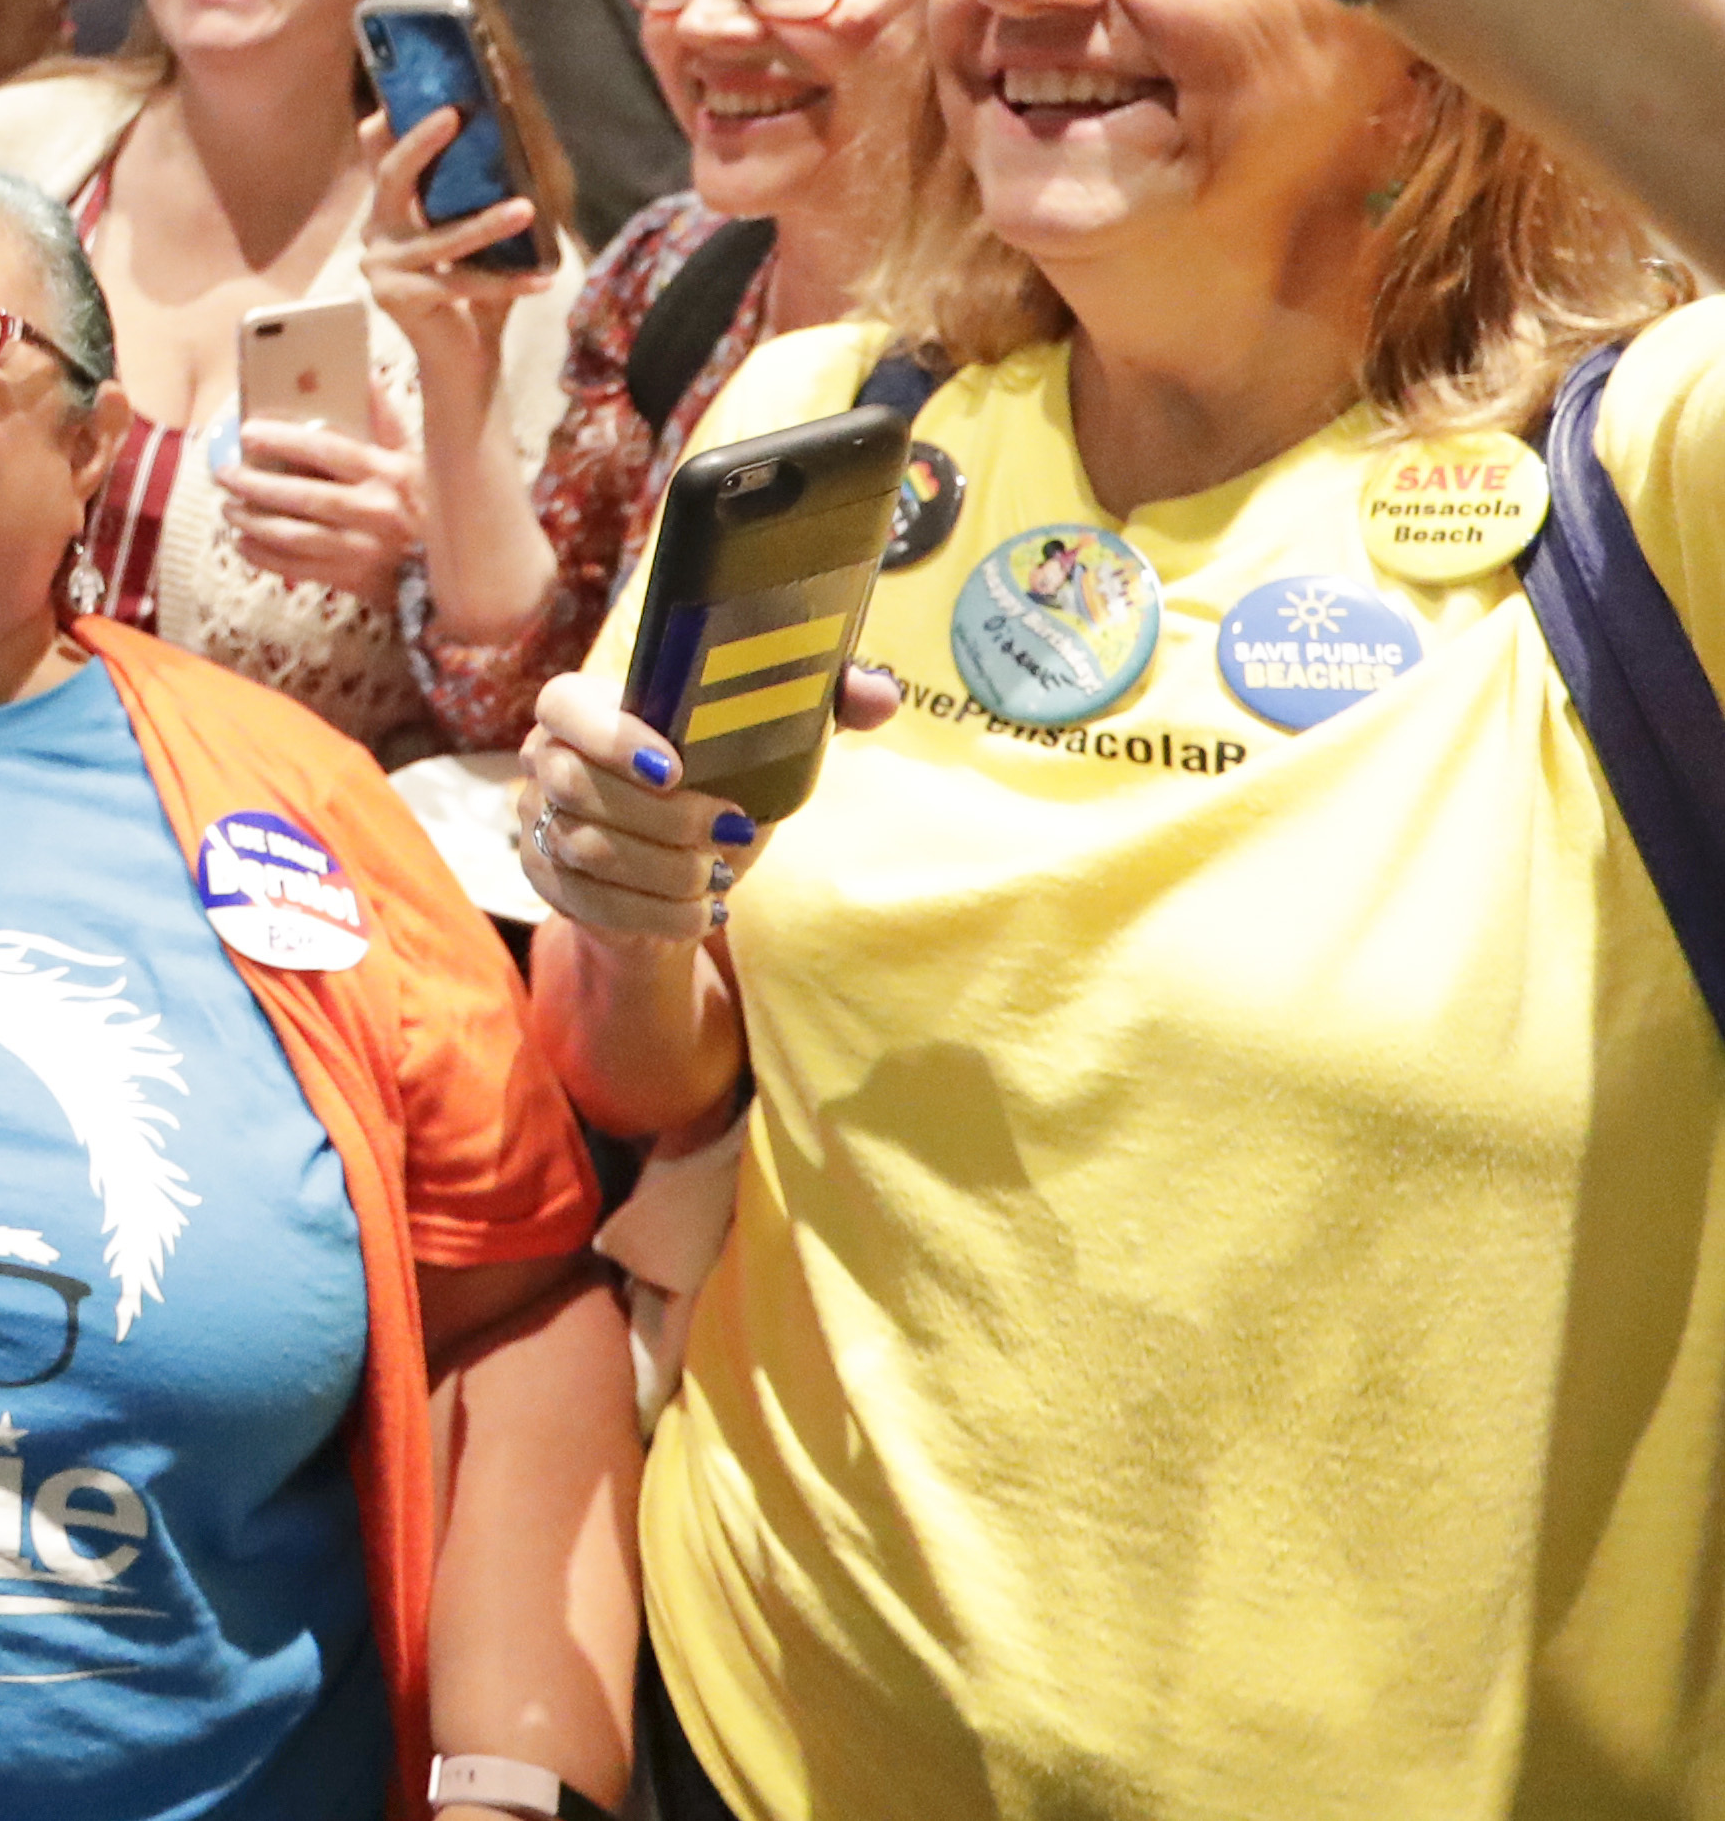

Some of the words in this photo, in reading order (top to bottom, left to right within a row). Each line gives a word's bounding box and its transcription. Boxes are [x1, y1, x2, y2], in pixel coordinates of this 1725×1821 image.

[1395, 464, 1511, 491] SAVE
[1370, 500, 1521, 517] Pensacola
[1393, 526, 1484, 543] Beach
[1233, 641, 1300, 664] SAVE
[1304, 641, 1403, 666] PUBLIC
[1243, 661, 1395, 691] BEACHES
